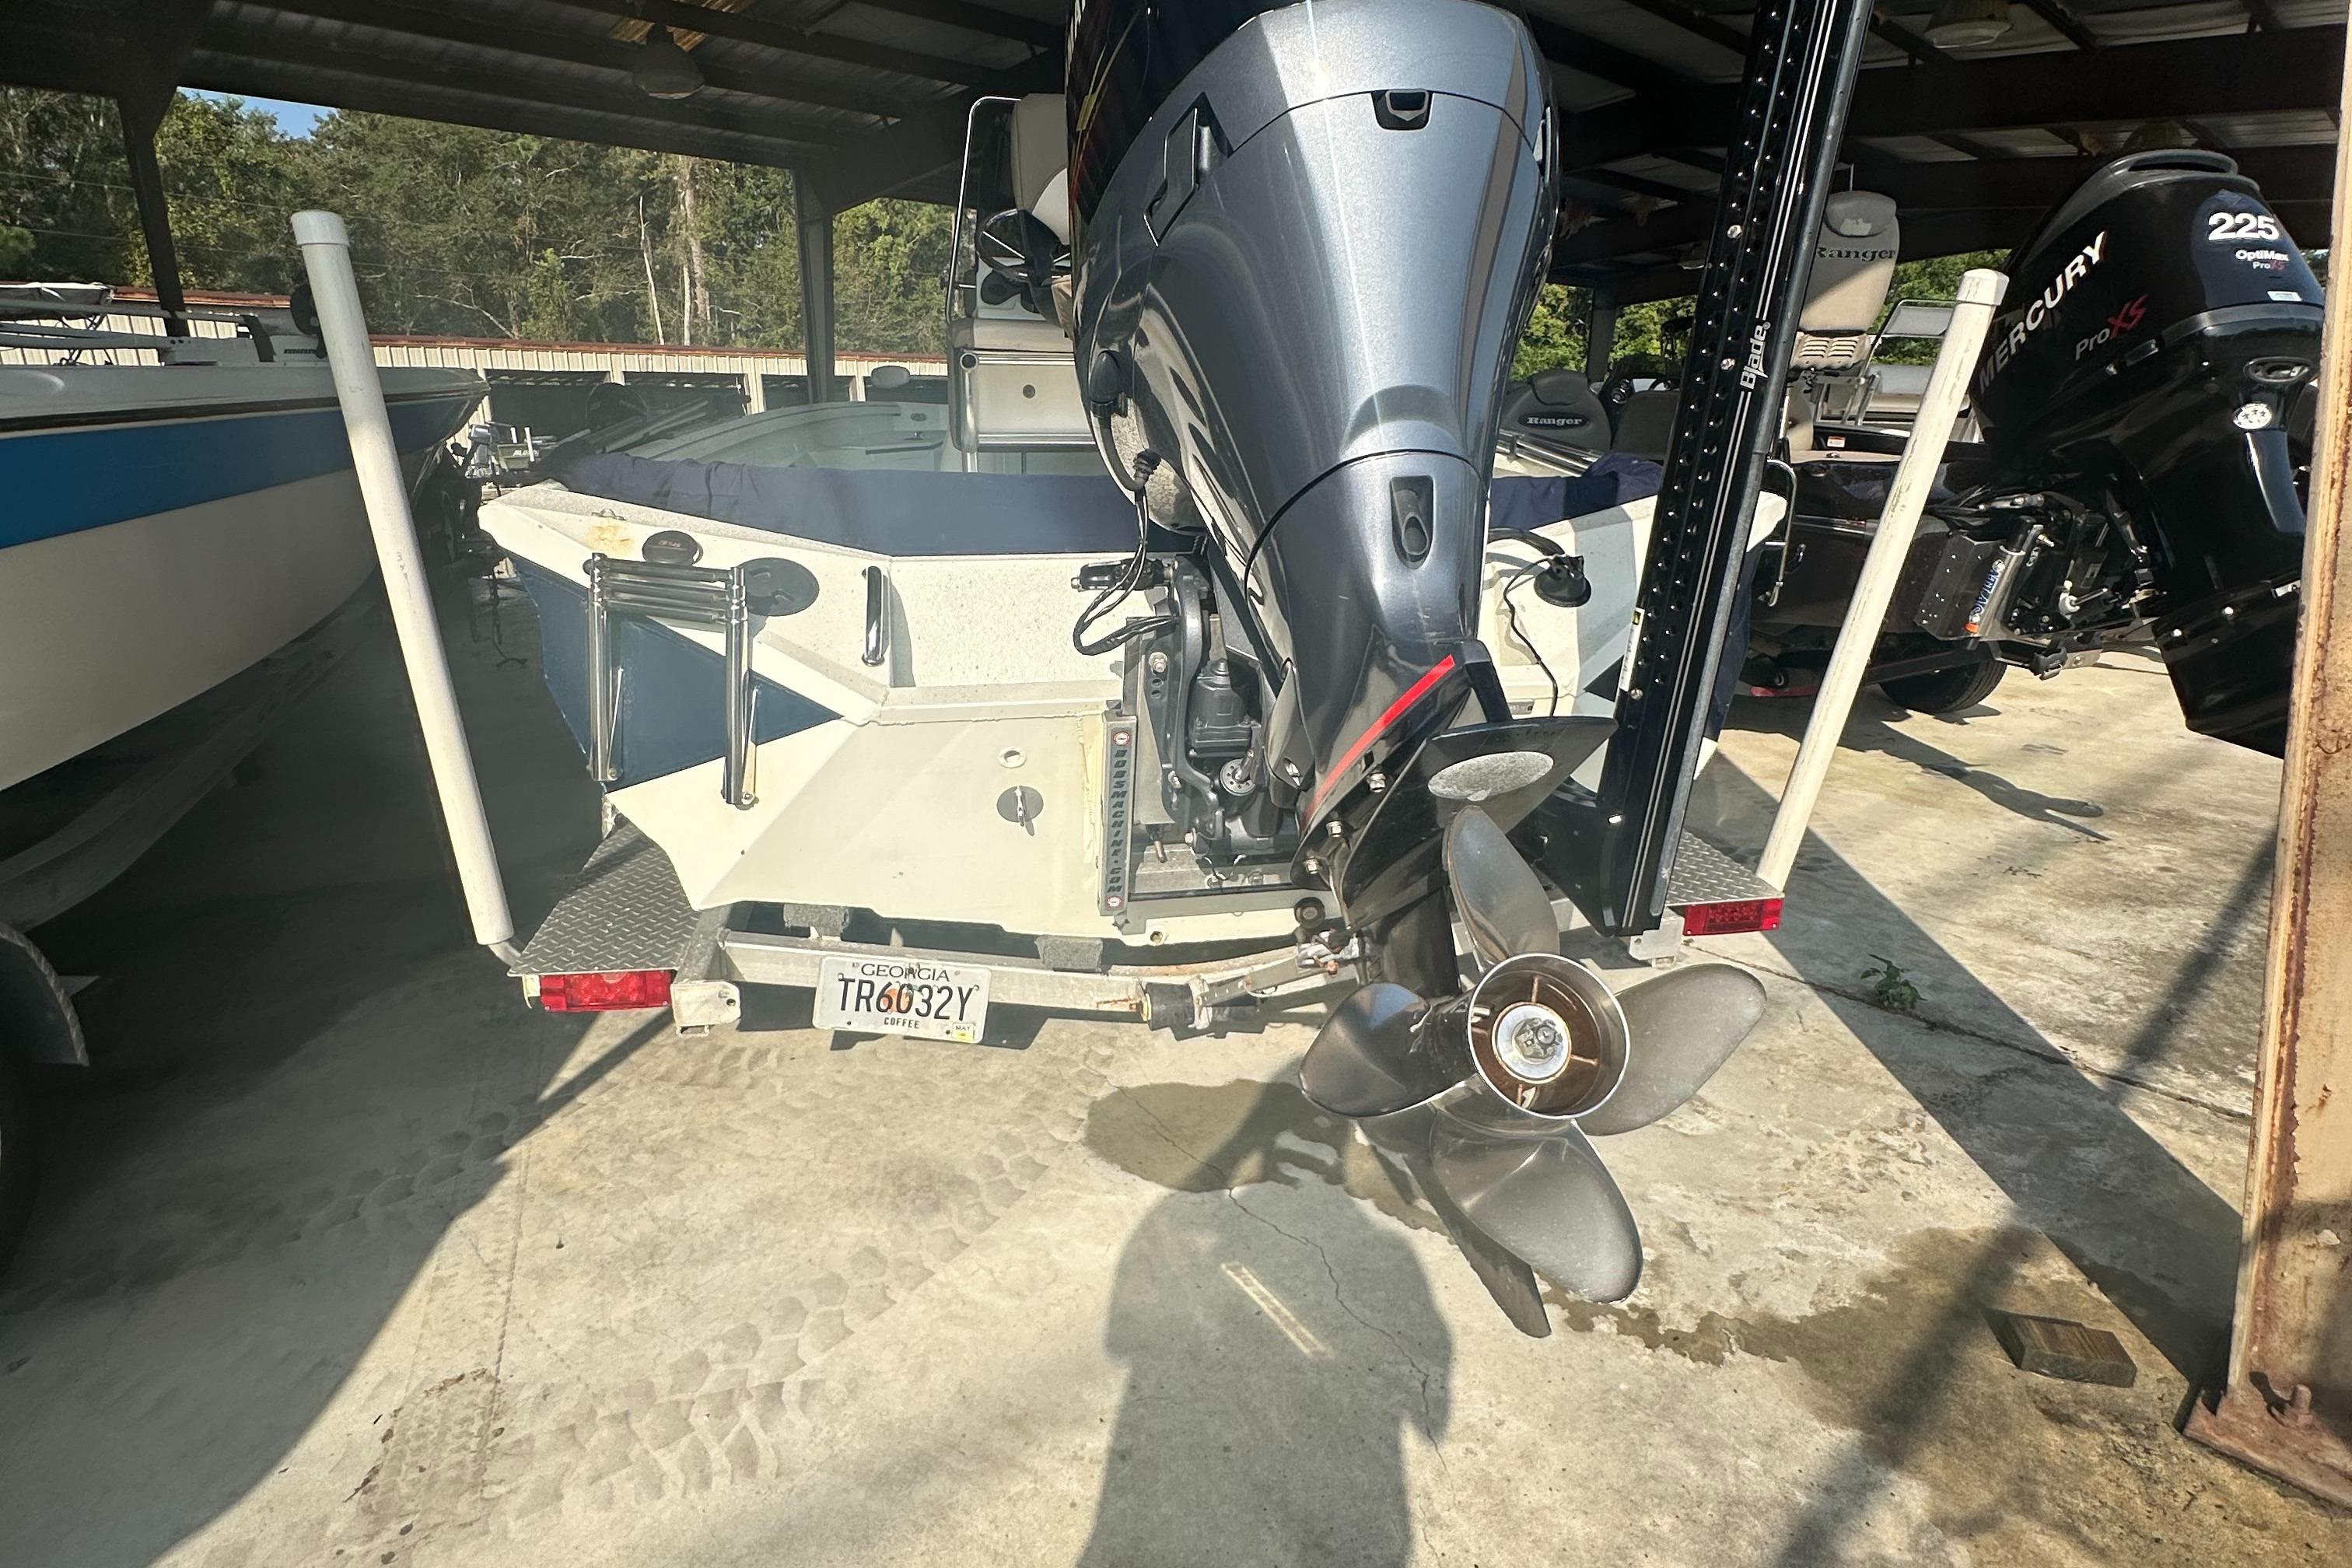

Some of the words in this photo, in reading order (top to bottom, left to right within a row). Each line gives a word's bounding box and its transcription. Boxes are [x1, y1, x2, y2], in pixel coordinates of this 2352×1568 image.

[2209, 212, 2280, 240] 225
[2235, 250, 2289, 262] OptiMax
[1979, 231, 2108, 393] MERCURY
[1527, 415, 1584, 427] Ranger
[860, 963, 950, 982] GEORGIA
[840, 977, 974, 1021] TR6032Y
[884, 1017, 920, 1029] COFFEE
